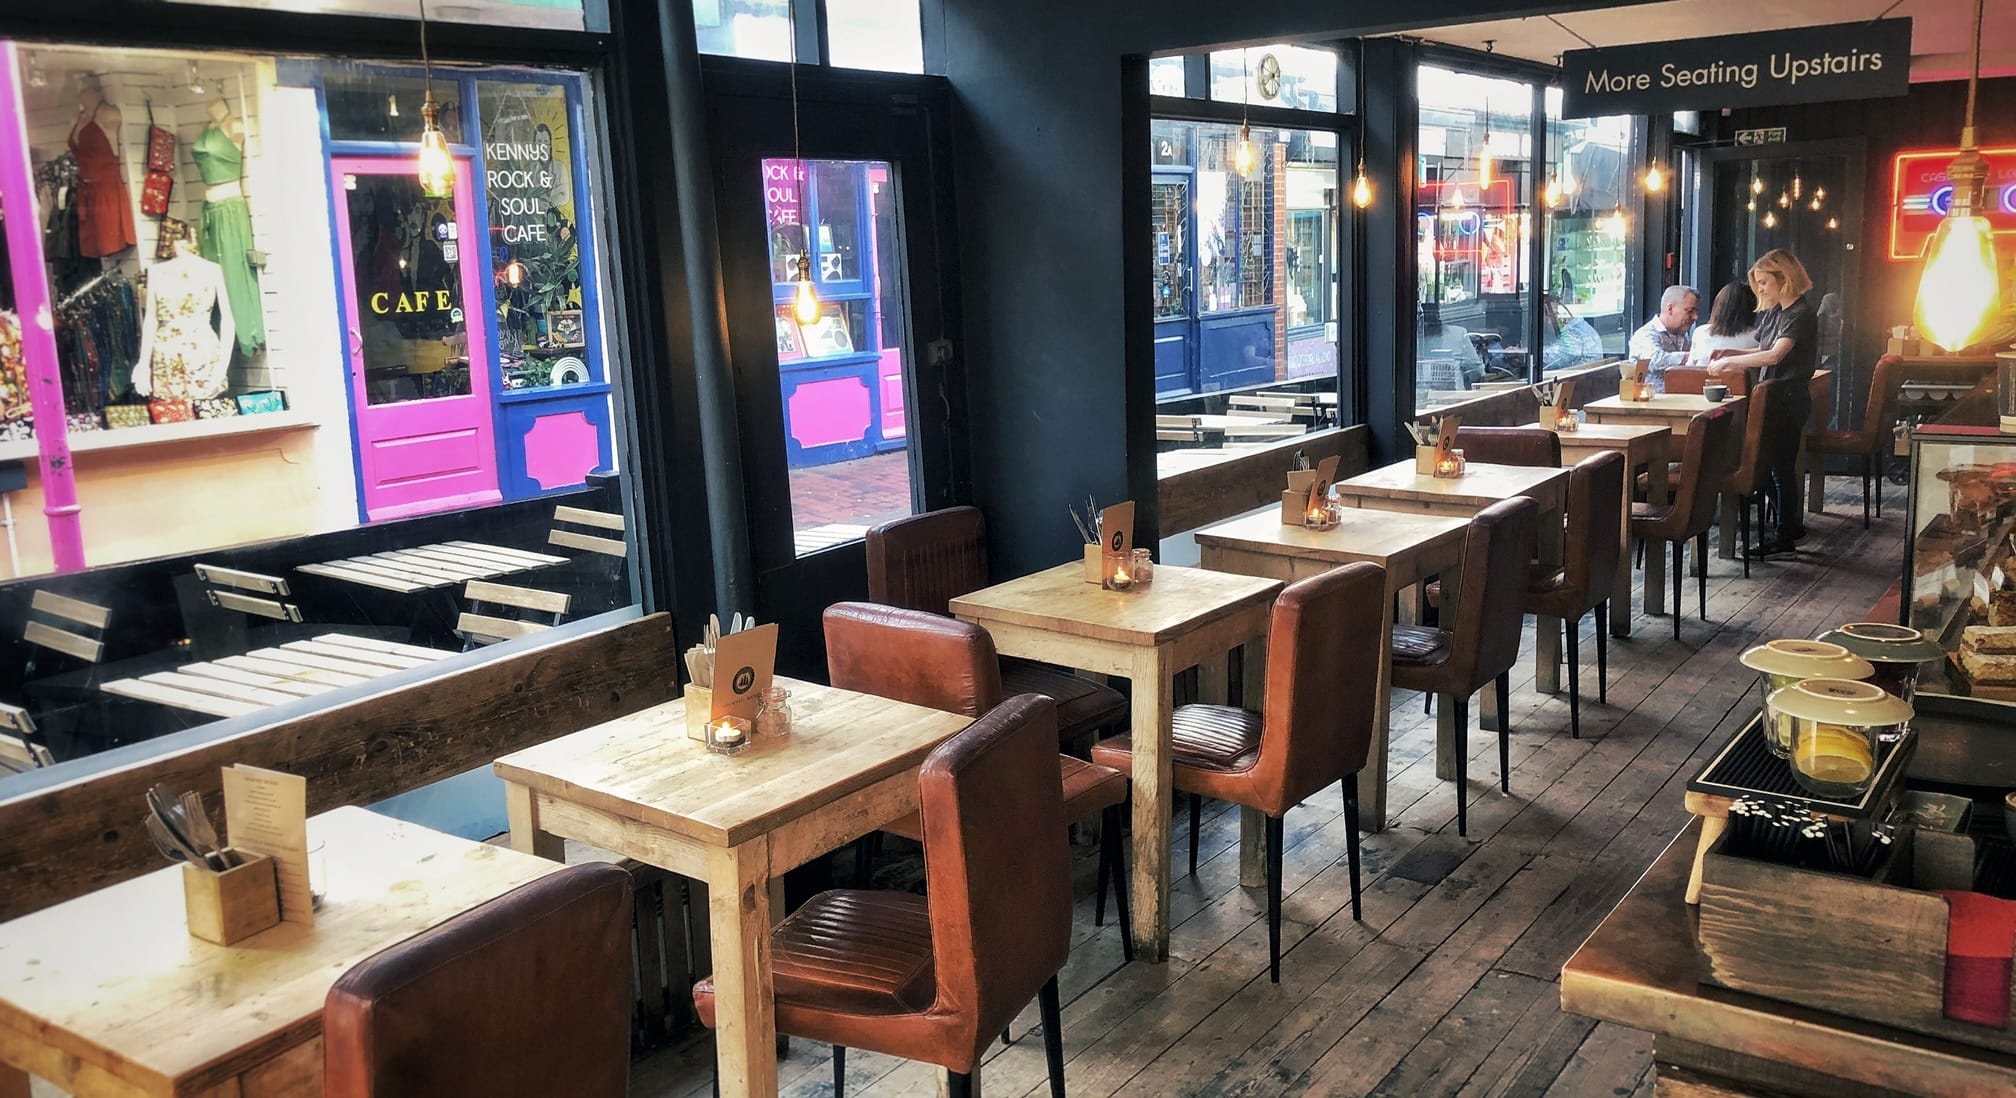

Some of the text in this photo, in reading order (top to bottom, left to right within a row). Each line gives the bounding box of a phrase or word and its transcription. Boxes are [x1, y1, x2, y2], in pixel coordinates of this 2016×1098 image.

[1584, 48, 1883, 95] More Seating Upstairs
[485, 143, 549, 162] KENNYS
[487, 170, 552, 189] ROCK &
[500, 197, 546, 216] SOUL
[504, 224, 547, 243] CAFE
[370, 290, 452, 314] CAFE
